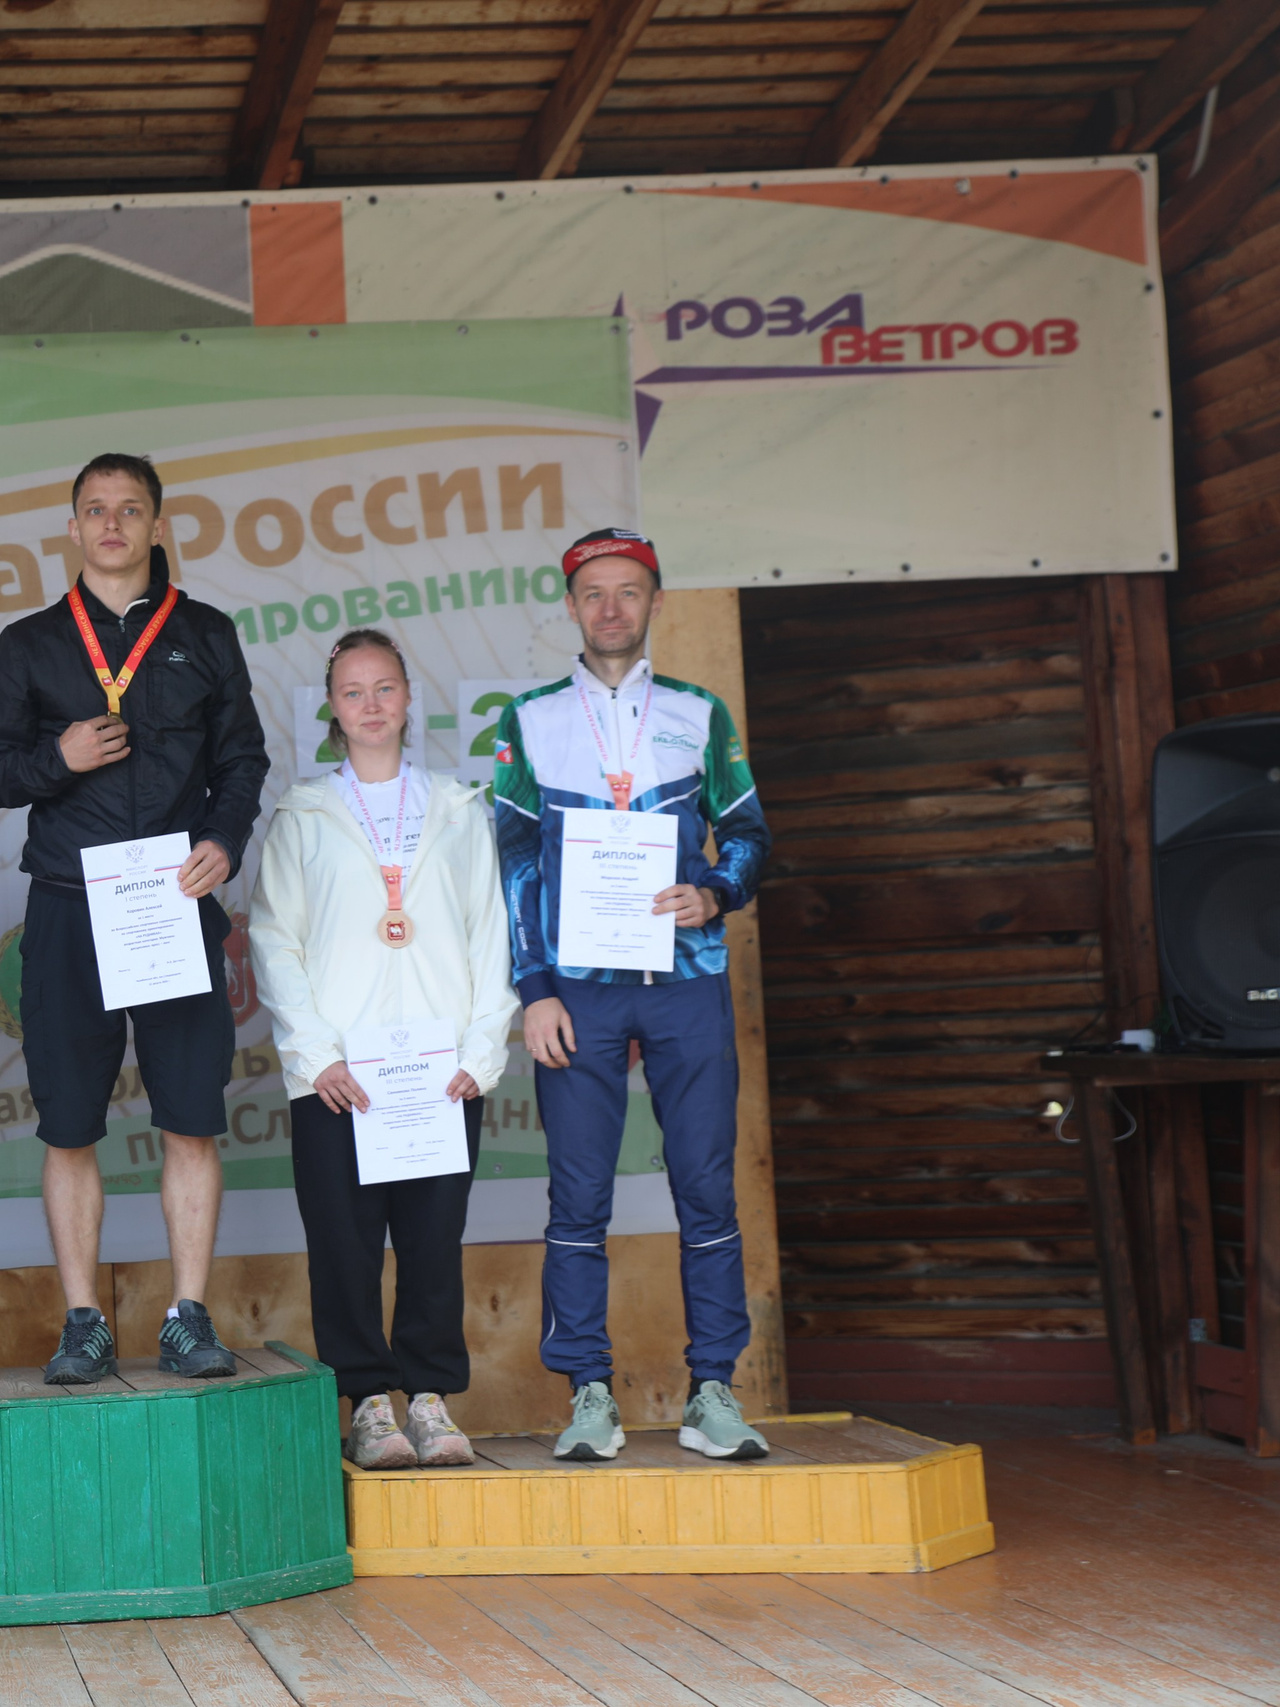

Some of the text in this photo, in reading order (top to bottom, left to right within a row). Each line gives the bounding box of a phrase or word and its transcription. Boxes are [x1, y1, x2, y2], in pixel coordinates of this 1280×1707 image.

[666, 293, 864, 341] РОЗА
[820, 317, 1080, 366] ВЕТРОВ
[592, 850, 646, 860] ДИПЛОМ
[115, 878, 165, 895] ДИПЛОМ
[378, 1063, 429, 1077] ДИПЛОМ
